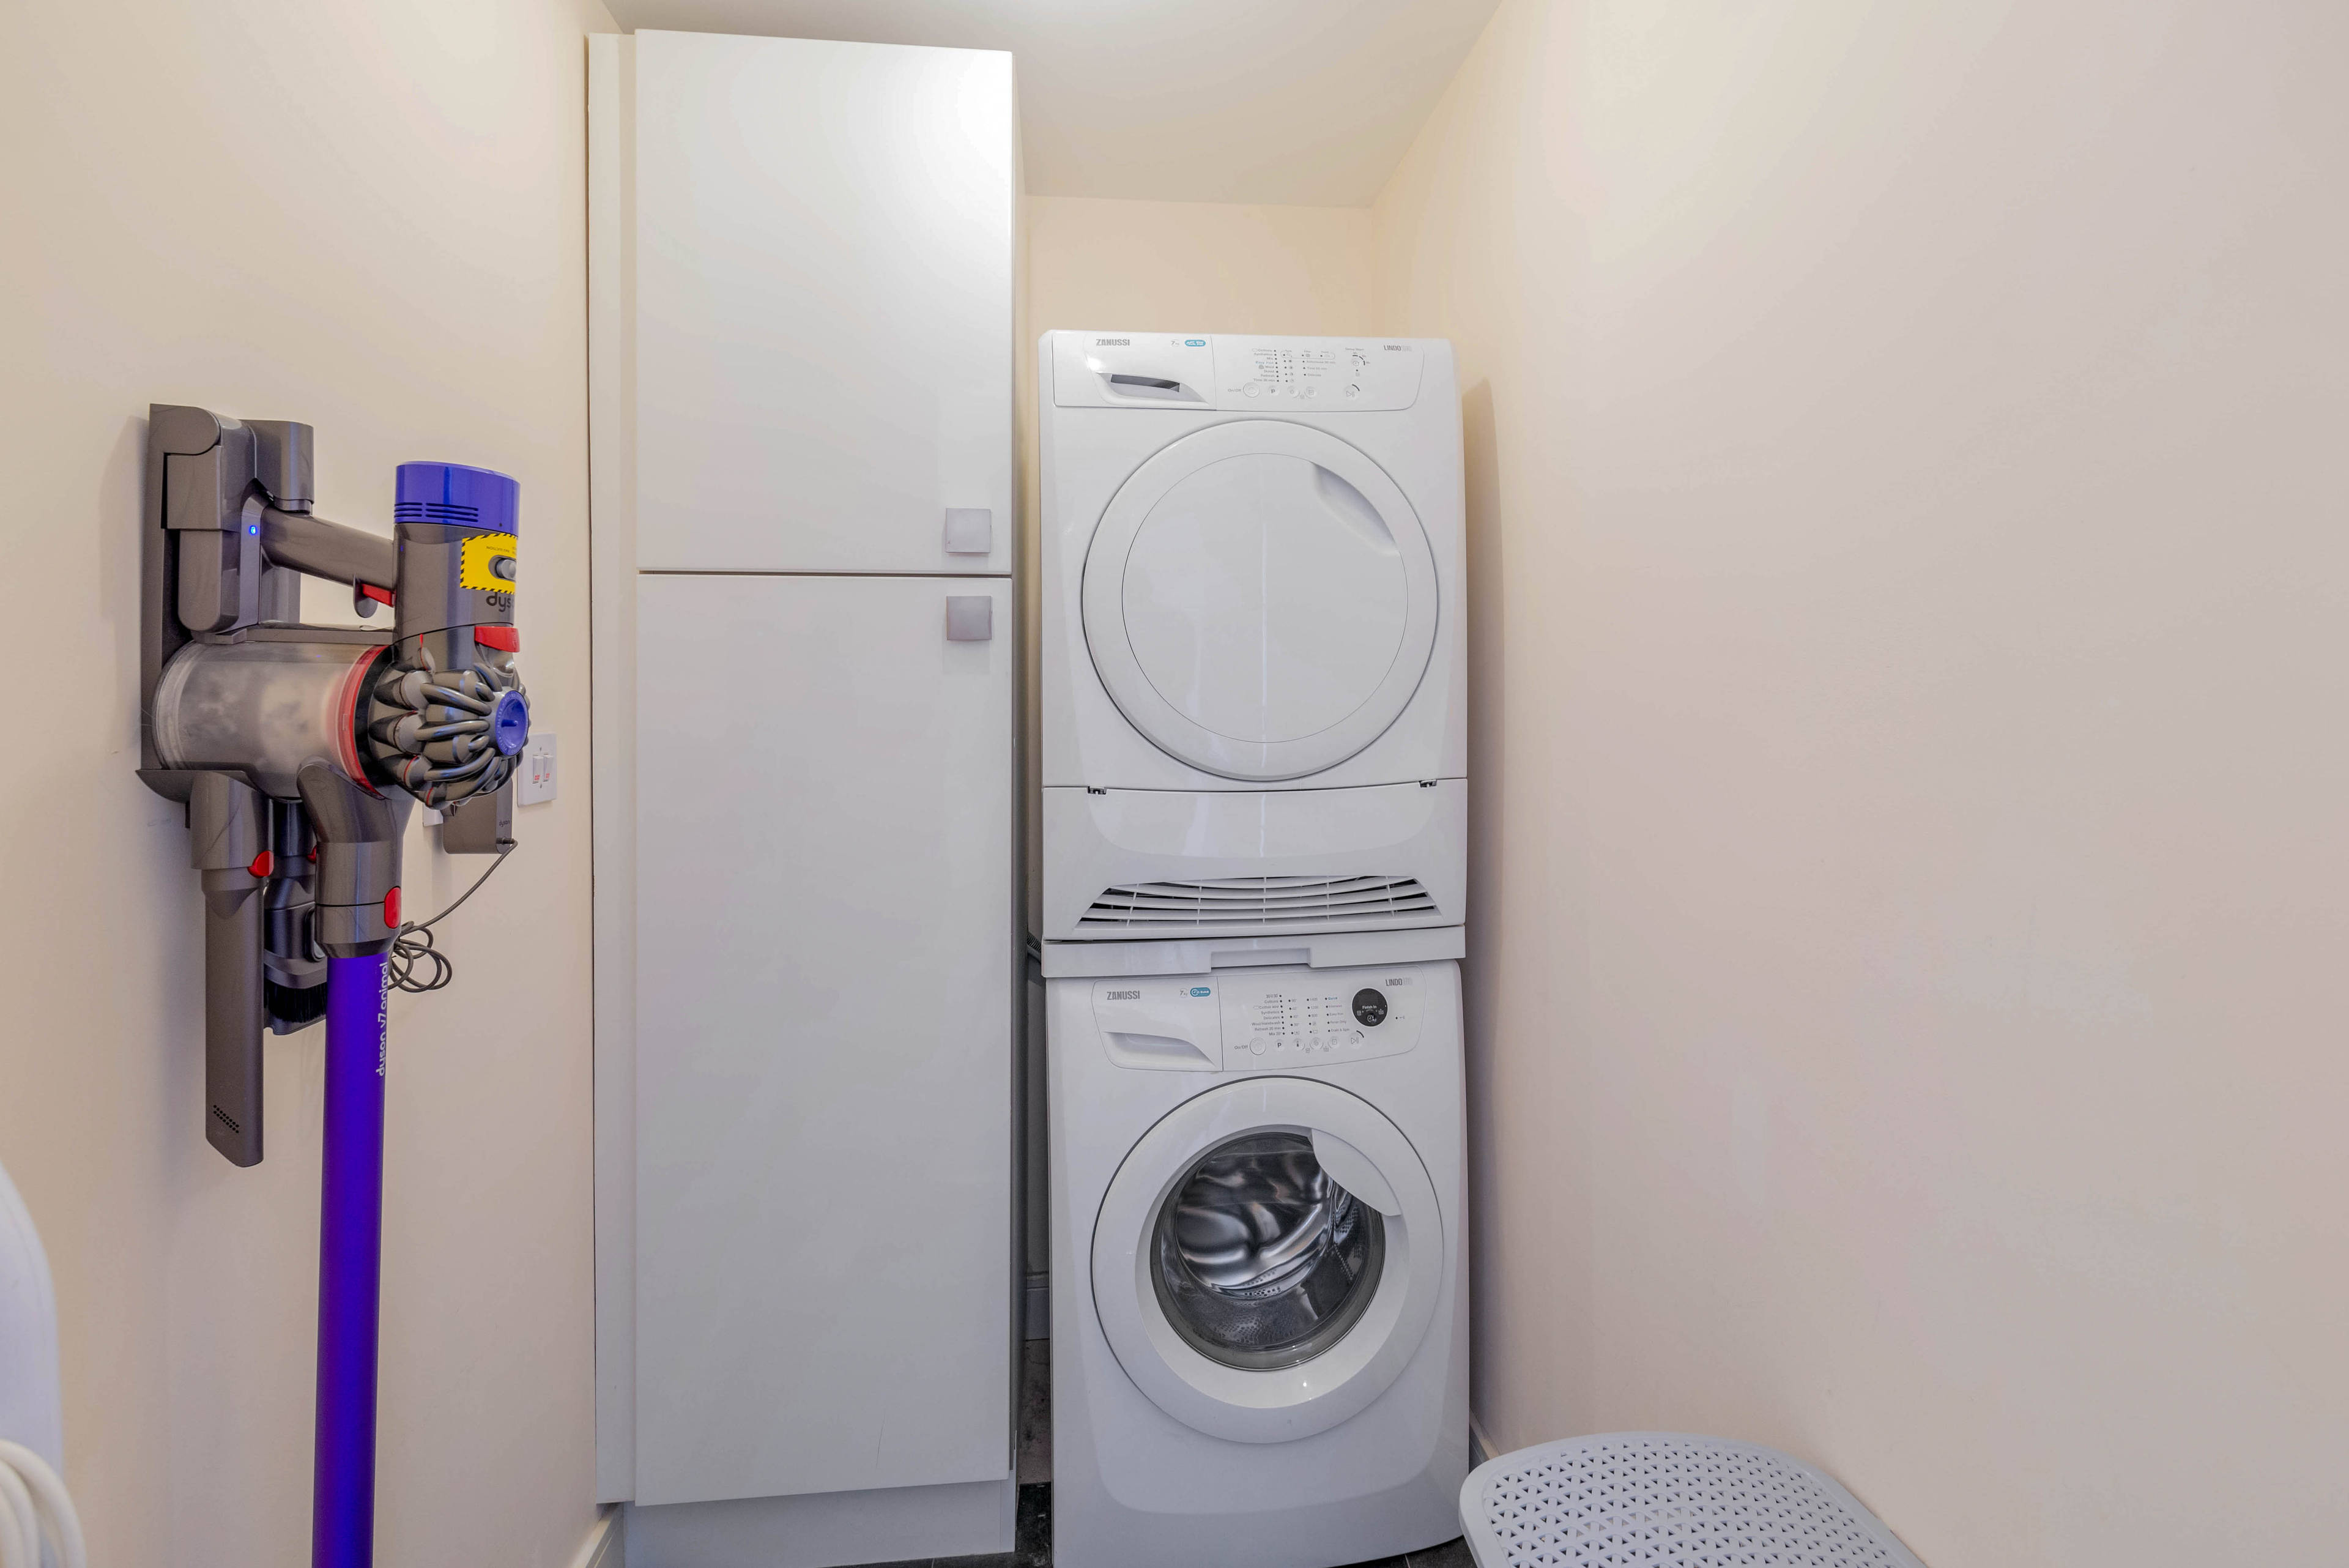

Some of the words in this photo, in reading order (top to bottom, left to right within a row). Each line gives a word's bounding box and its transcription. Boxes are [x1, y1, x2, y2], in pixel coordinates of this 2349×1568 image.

[379, 961, 388, 1010] animal
[1107, 990, 1140, 1000] ZANUSSI
[377, 1013, 387, 1028] v7
[375, 1031, 386, 1077] dyson
